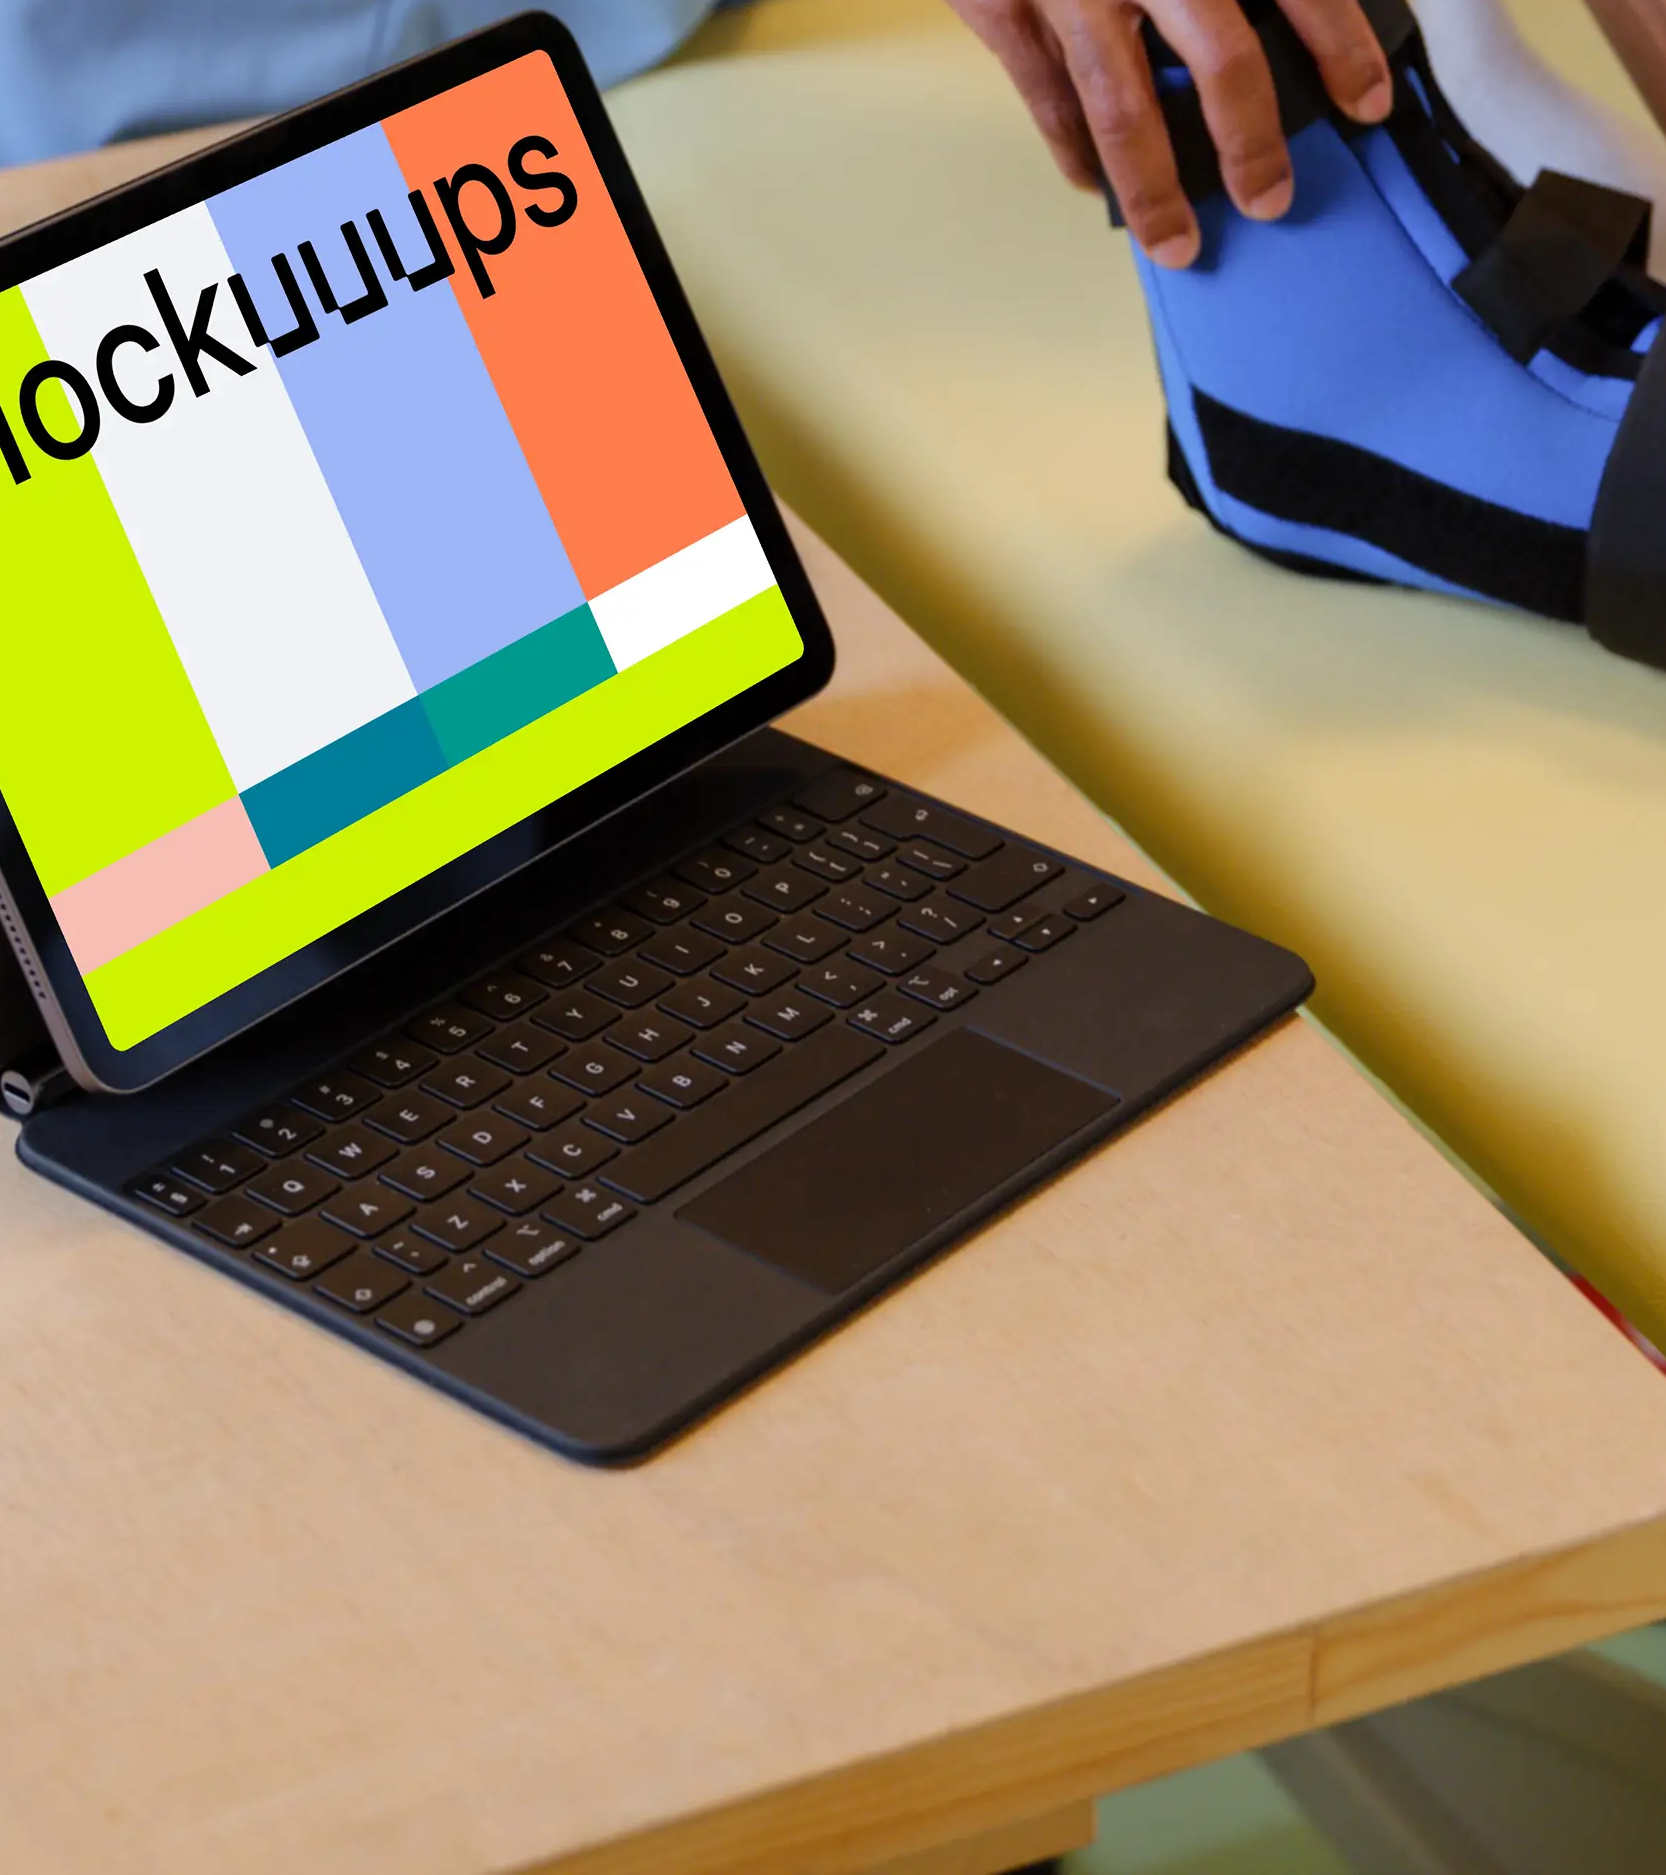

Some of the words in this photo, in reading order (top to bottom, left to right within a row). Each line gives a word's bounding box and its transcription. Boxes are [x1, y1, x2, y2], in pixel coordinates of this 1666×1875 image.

[278, 1127, 297, 1140] 2
[335, 1093, 354, 1105] 3
[395, 1059, 411, 1070] 4
[448, 1025, 467, 1037] 5
[557, 960, 573, 972] 7
[282, 1180, 305, 1193] Q
[338, 1142, 362, 1158] W
[399, 1109, 419, 1122] E
[455, 1075, 476, 1088] R
[510, 1041, 529, 1052] T
[565, 1008, 583, 1019] Y
[618, 975, 639, 988] U
[774, 882, 789, 894] P
[359, 1203, 379, 1216] A
[416, 1165, 436, 1179] S
[472, 1131, 493, 1145] D
[529, 1096, 544, 1109] F
[585, 1062, 604, 1075] G
[638, 1028, 660, 1042] H
[697, 995, 711, 1008] J
[744, 963, 764, 976] K
[796, 934, 816, 944] L
[447, 1214, 469, 1230] Z
[505, 1178, 527, 1193] X
[562, 1143, 582, 1157] C
[616, 1108, 636, 1121] V
[672, 1075, 692, 1088] B
[725, 1041, 747, 1054] N
[777, 1006, 800, 1021] M
